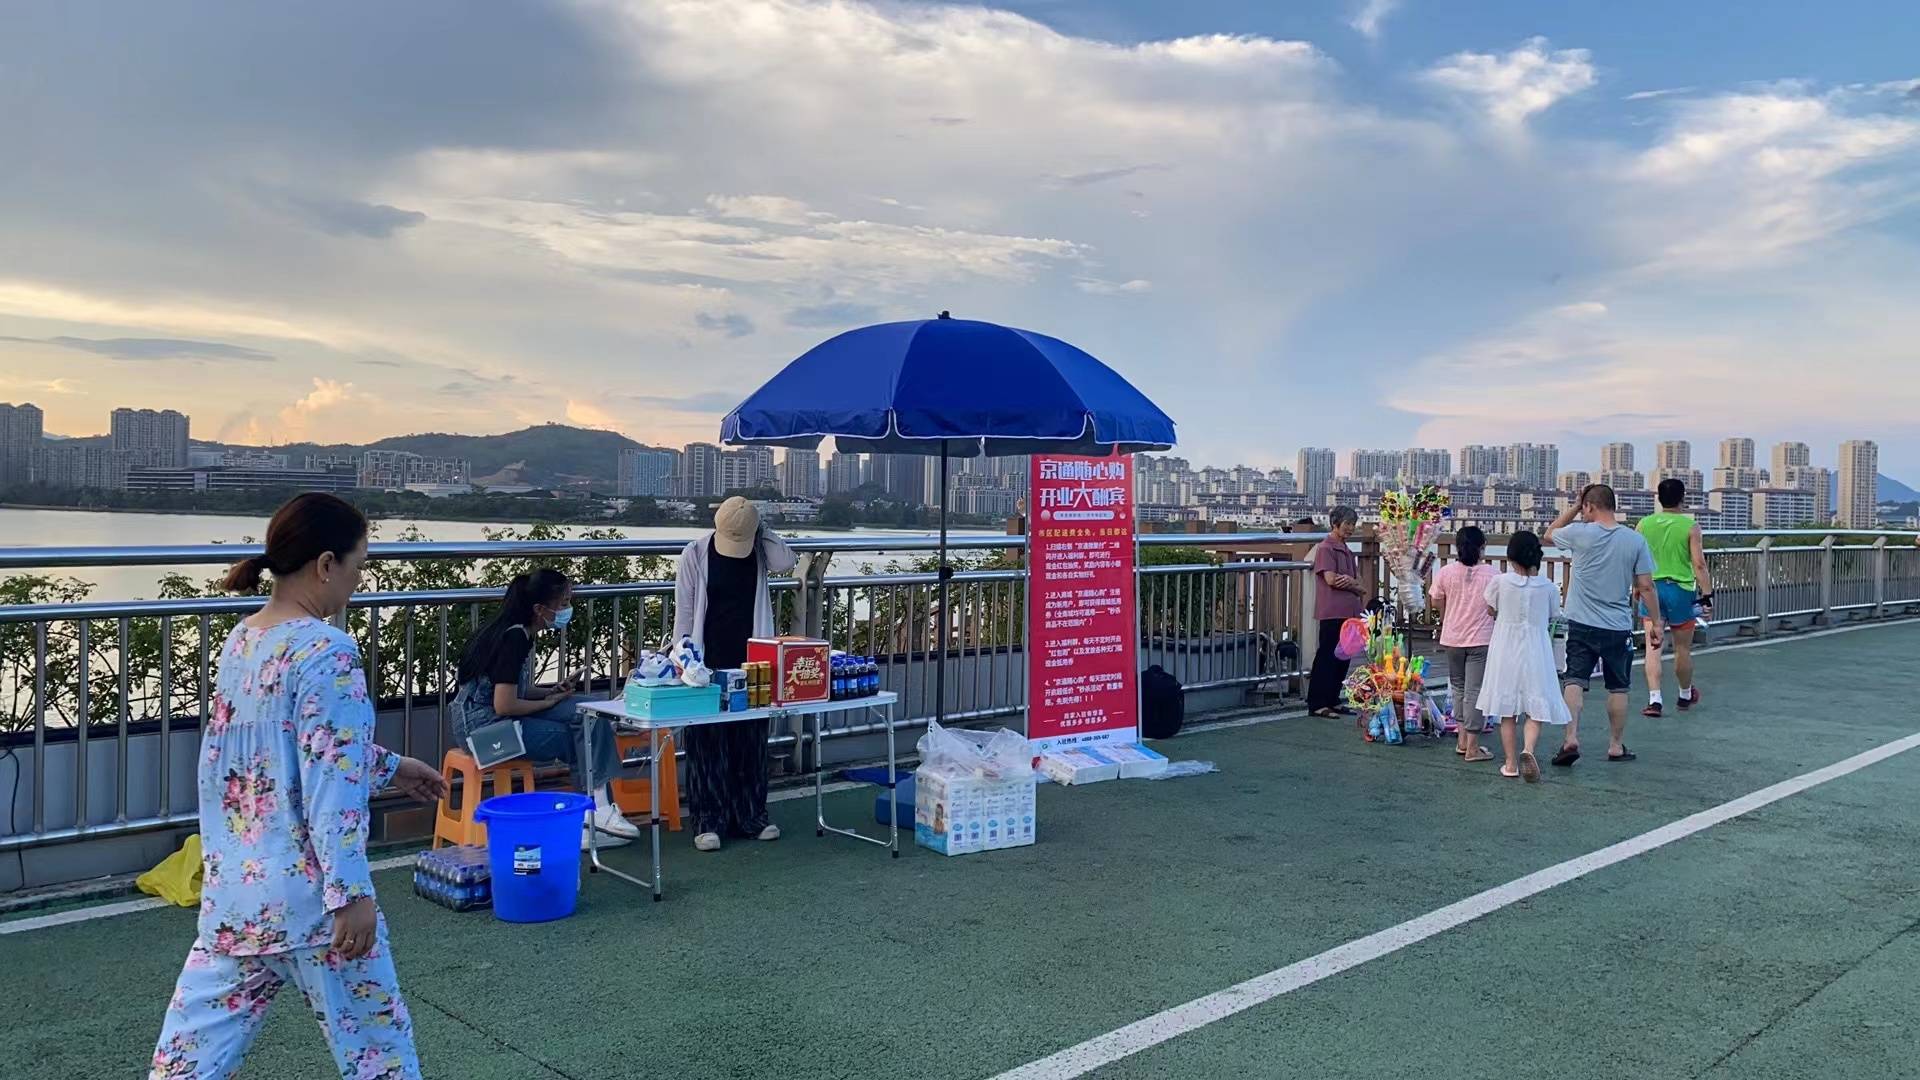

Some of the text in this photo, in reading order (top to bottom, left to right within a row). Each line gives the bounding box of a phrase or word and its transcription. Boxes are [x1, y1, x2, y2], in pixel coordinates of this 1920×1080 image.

[1040, 459, 1125, 480] 京通随心购
[1039, 482, 1125, 508] 开业大酬宾
